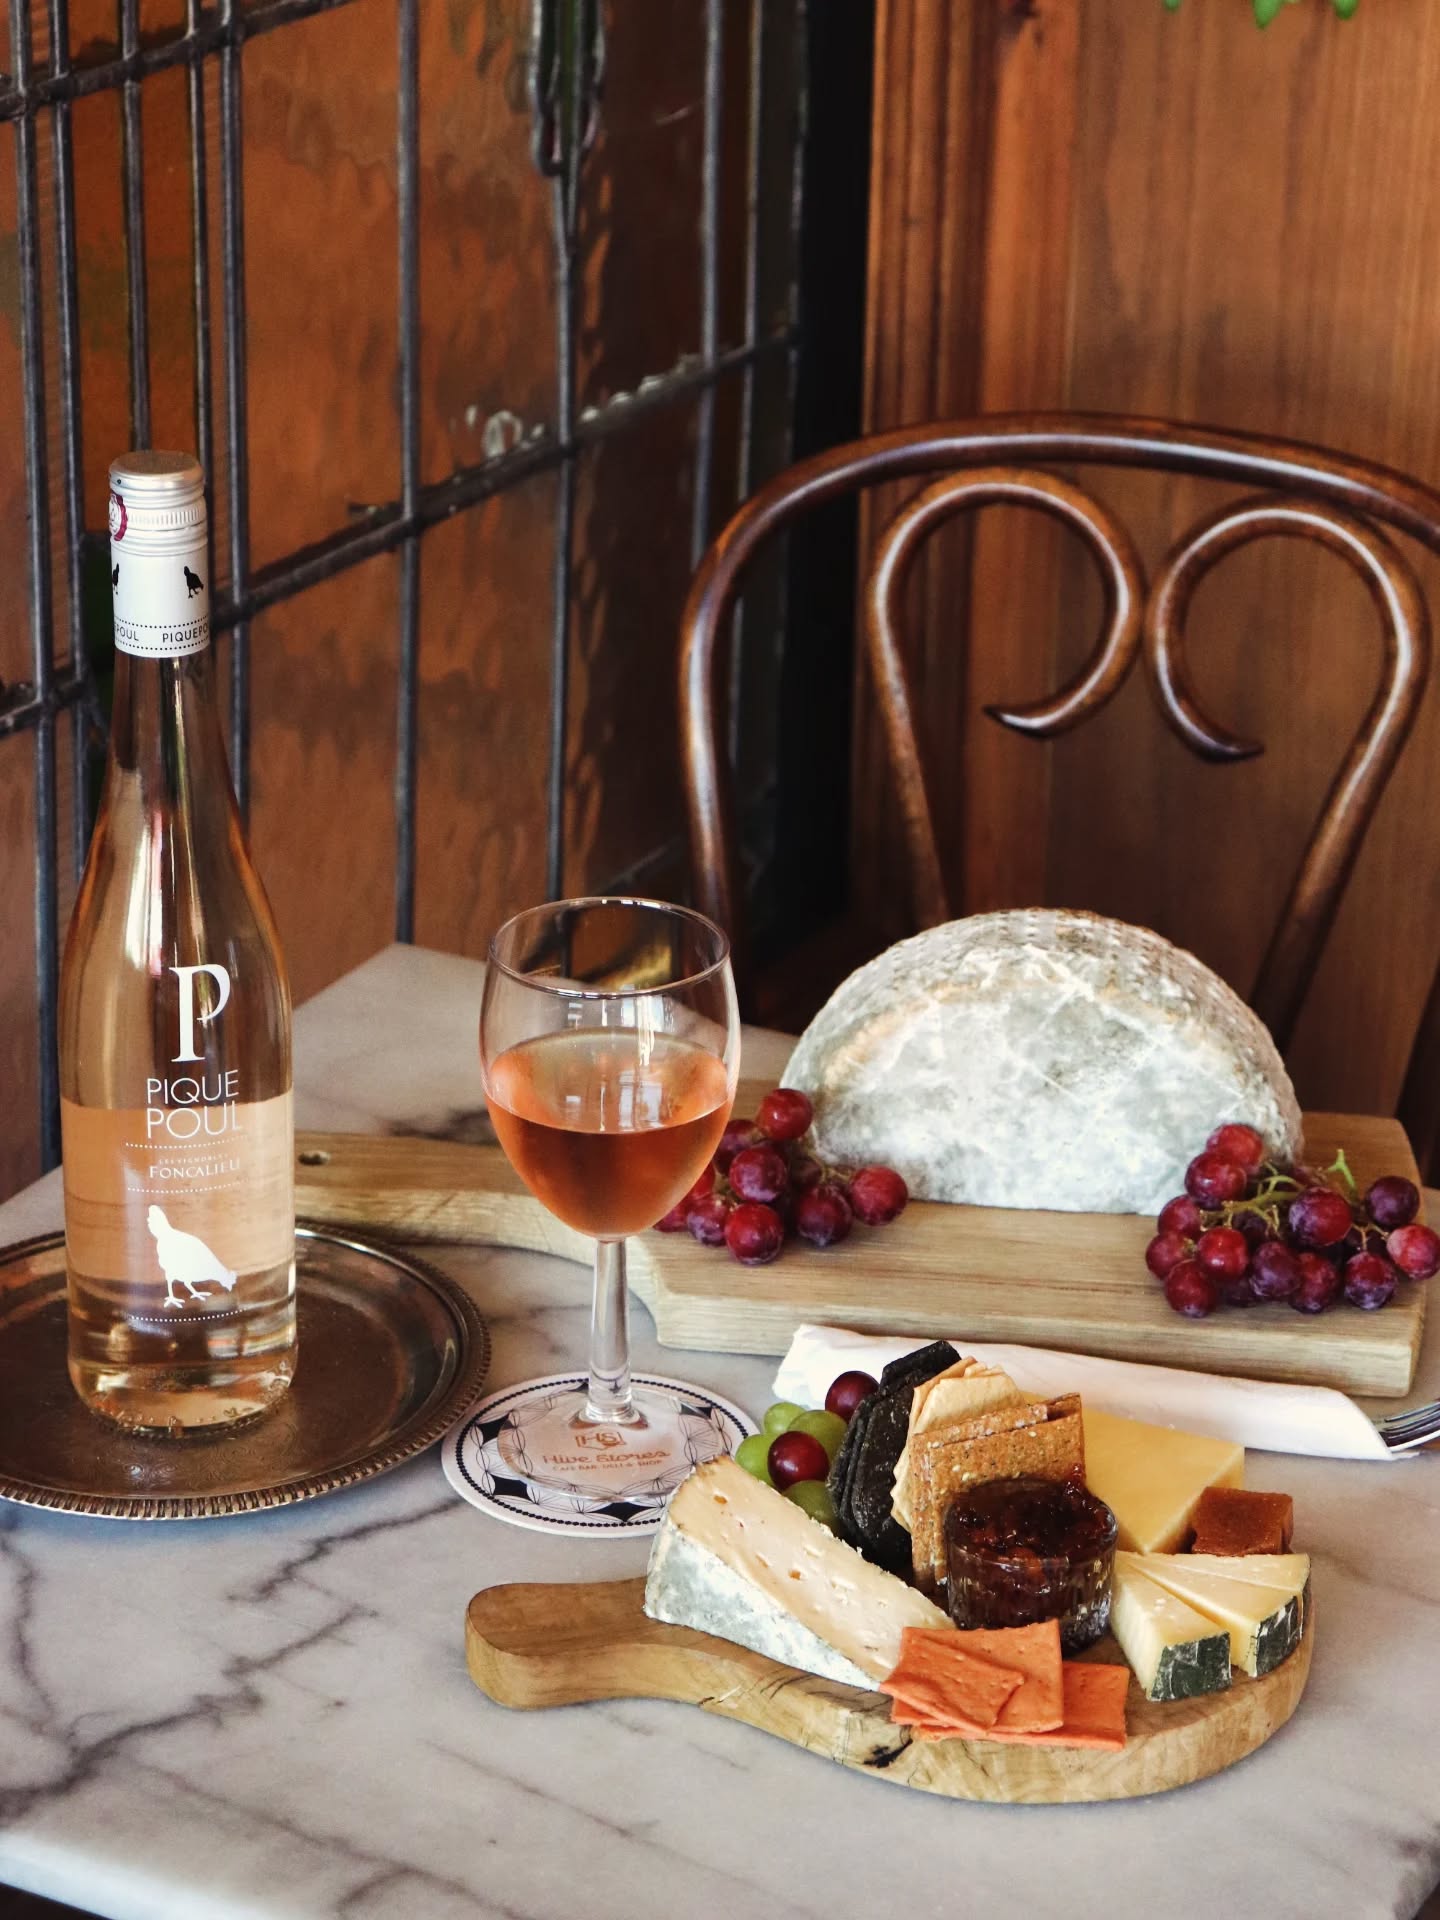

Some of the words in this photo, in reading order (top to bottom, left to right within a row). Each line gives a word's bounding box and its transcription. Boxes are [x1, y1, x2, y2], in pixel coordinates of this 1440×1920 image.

[168, 963, 231, 1062] P
[146, 1069, 239, 1104] PIQUE
[146, 1100, 242, 1139] POUL
[543, 1454, 589, 1465] Hive
[596, 1450, 671, 1463] Stores
